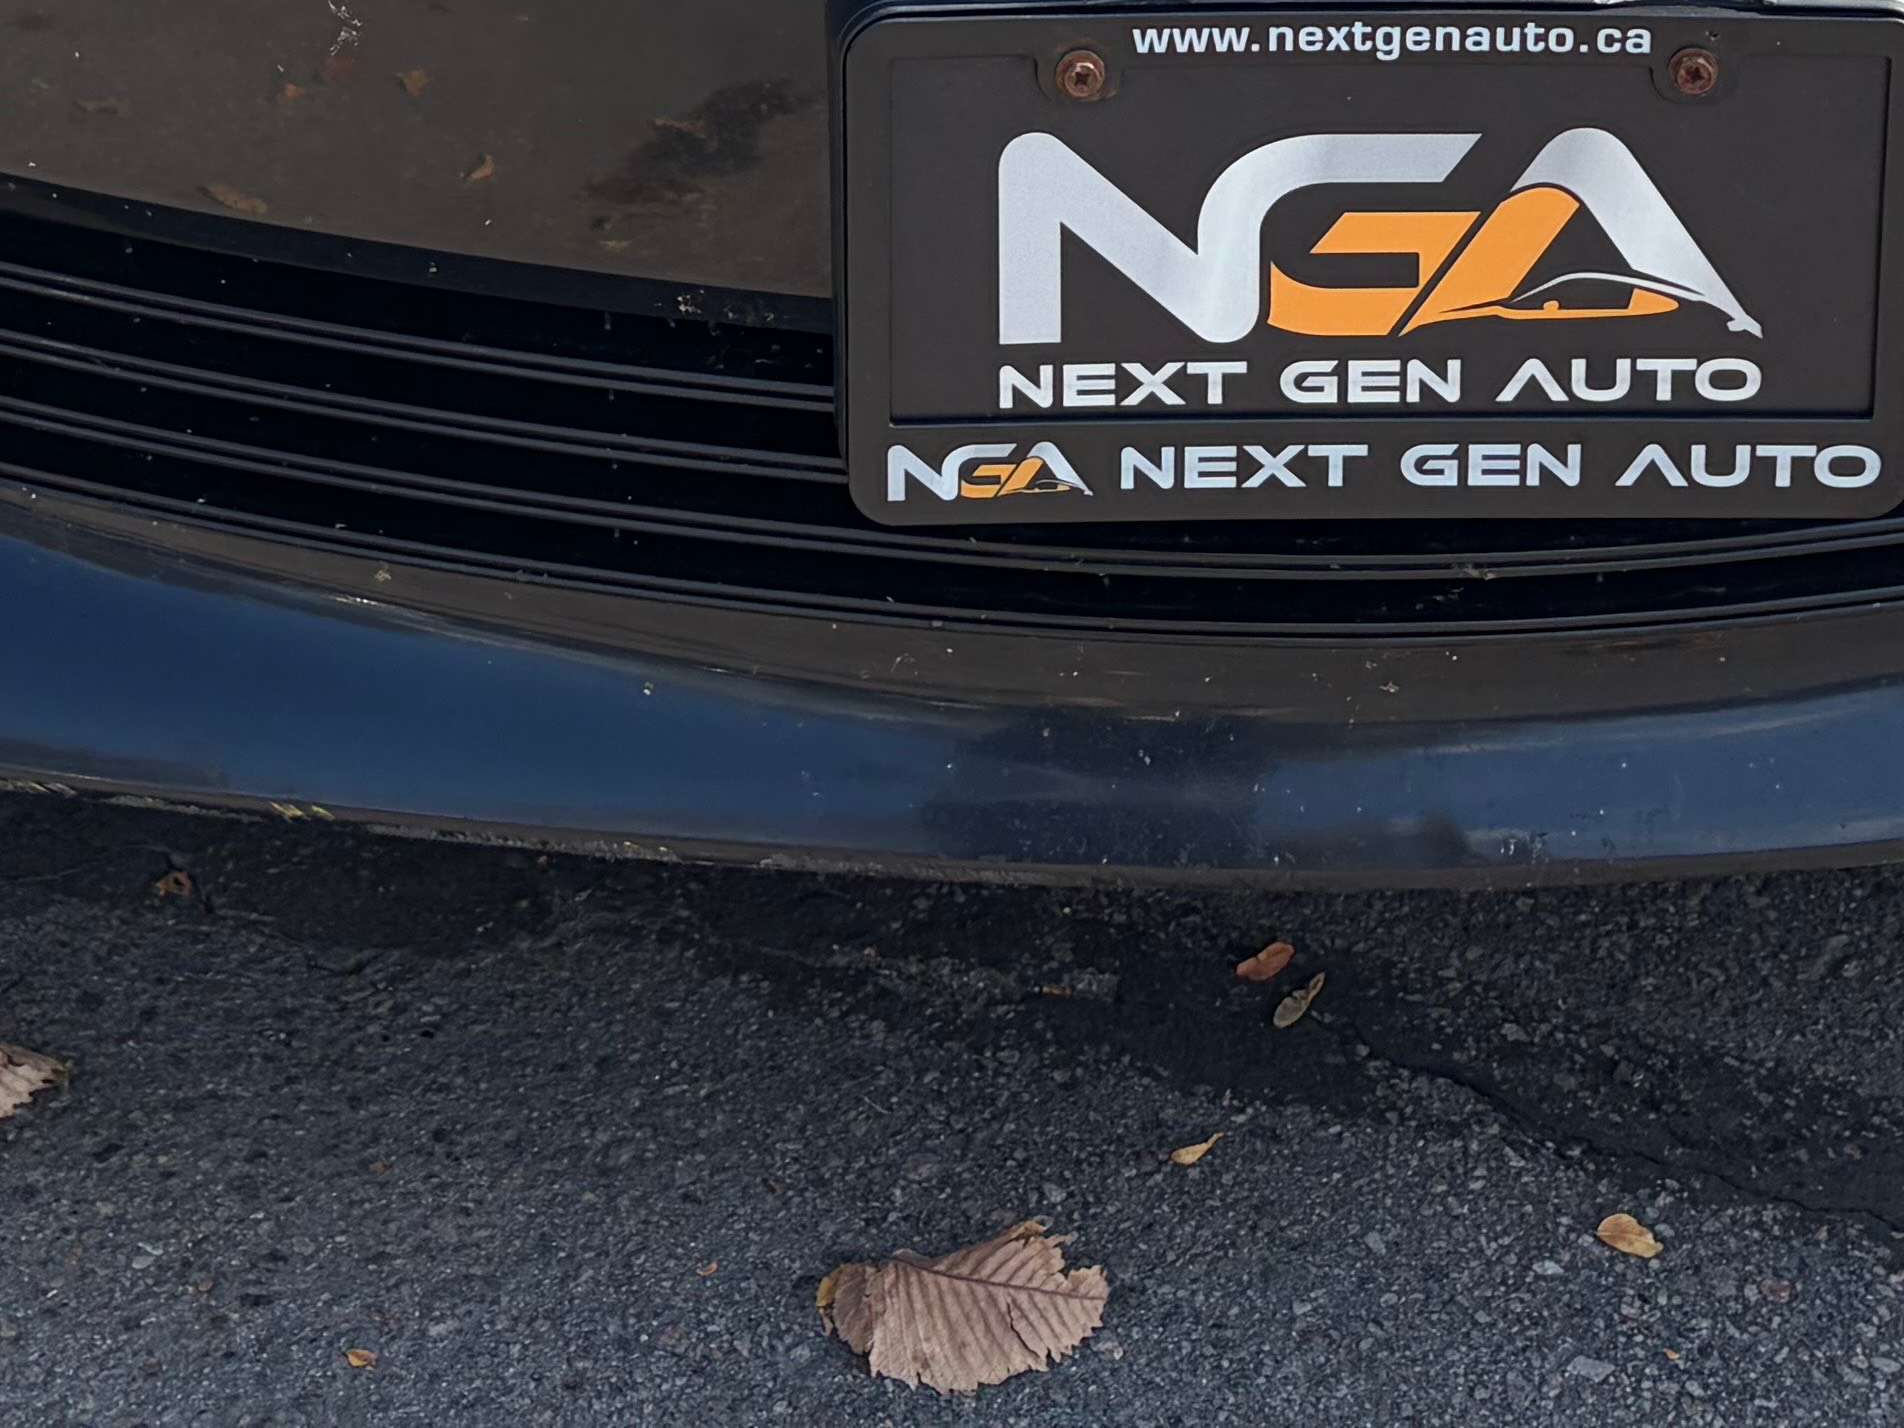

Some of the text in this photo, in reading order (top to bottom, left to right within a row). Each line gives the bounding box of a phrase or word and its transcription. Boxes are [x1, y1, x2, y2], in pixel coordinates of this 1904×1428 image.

[1132, 22, 1652, 61] www.nextgenauto.ca
[998, 127, 1763, 345] NGA
[999, 357, 1762, 409] NEXT GEN AUTO
[887, 441, 1882, 502] NGA NEXT GEN AUTO
